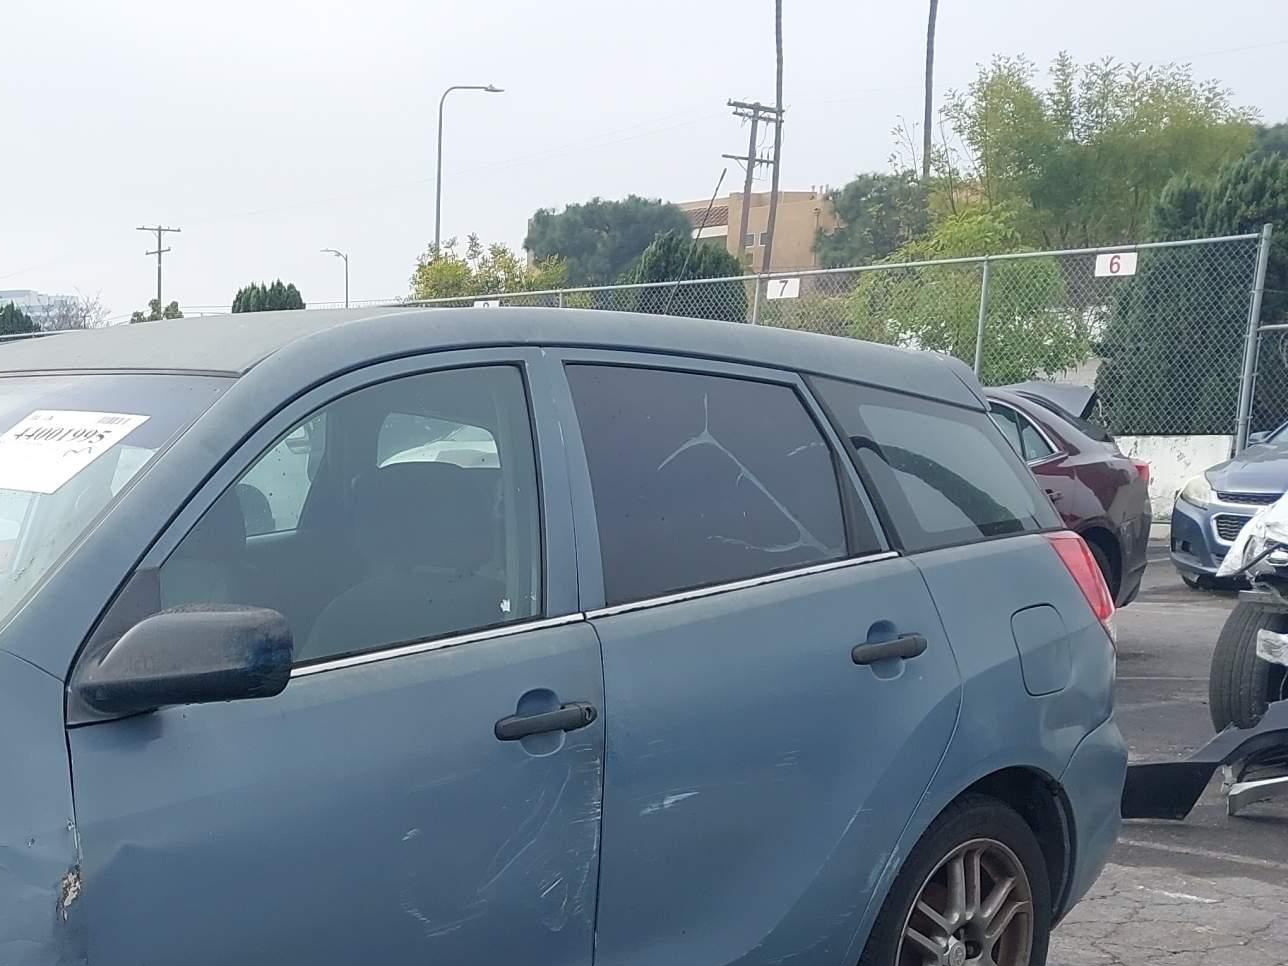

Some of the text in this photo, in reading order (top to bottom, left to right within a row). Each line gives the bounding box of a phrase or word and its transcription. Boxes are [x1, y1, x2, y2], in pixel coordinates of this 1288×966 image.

[1109, 254, 1121, 275] 6
[778, 279, 789, 297] 7
[14, 425, 112, 444] 44001995
